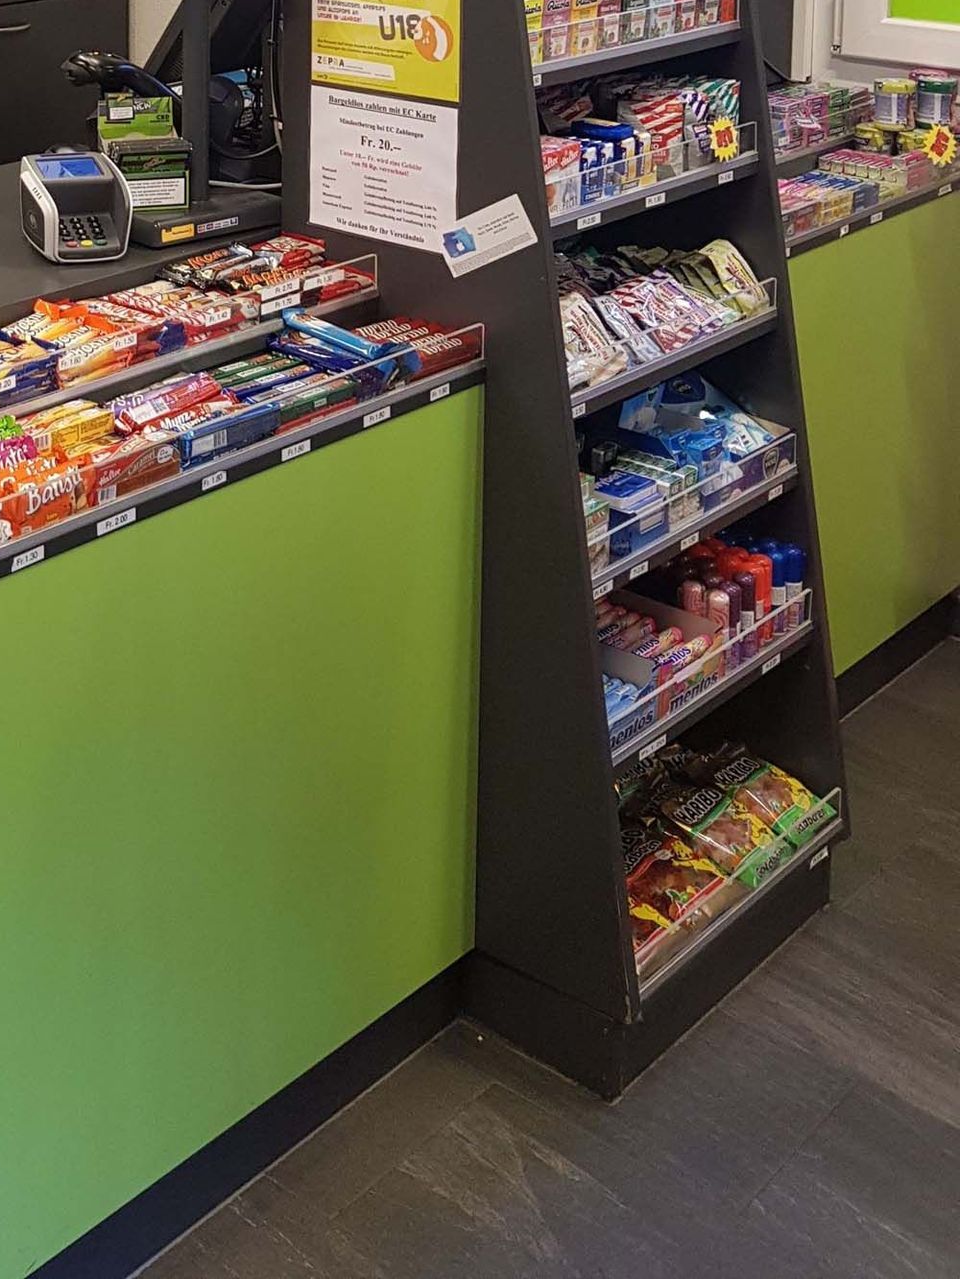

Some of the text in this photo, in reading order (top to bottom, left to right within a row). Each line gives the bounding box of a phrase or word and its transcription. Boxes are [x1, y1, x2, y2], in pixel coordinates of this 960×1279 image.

[329, 95, 437, 121] Bargeldlos zahlen mit EC Karte
[360, 135, 376, 148] Fr.
[396, 128, 424, 138] Zahlungen
[348, 221, 425, 243] danken für Ihr Verständnis
[669, 672, 719, 713] mentos
[714, 757, 760, 787] HARIBO
[674, 788, 722, 825] HARIBO
